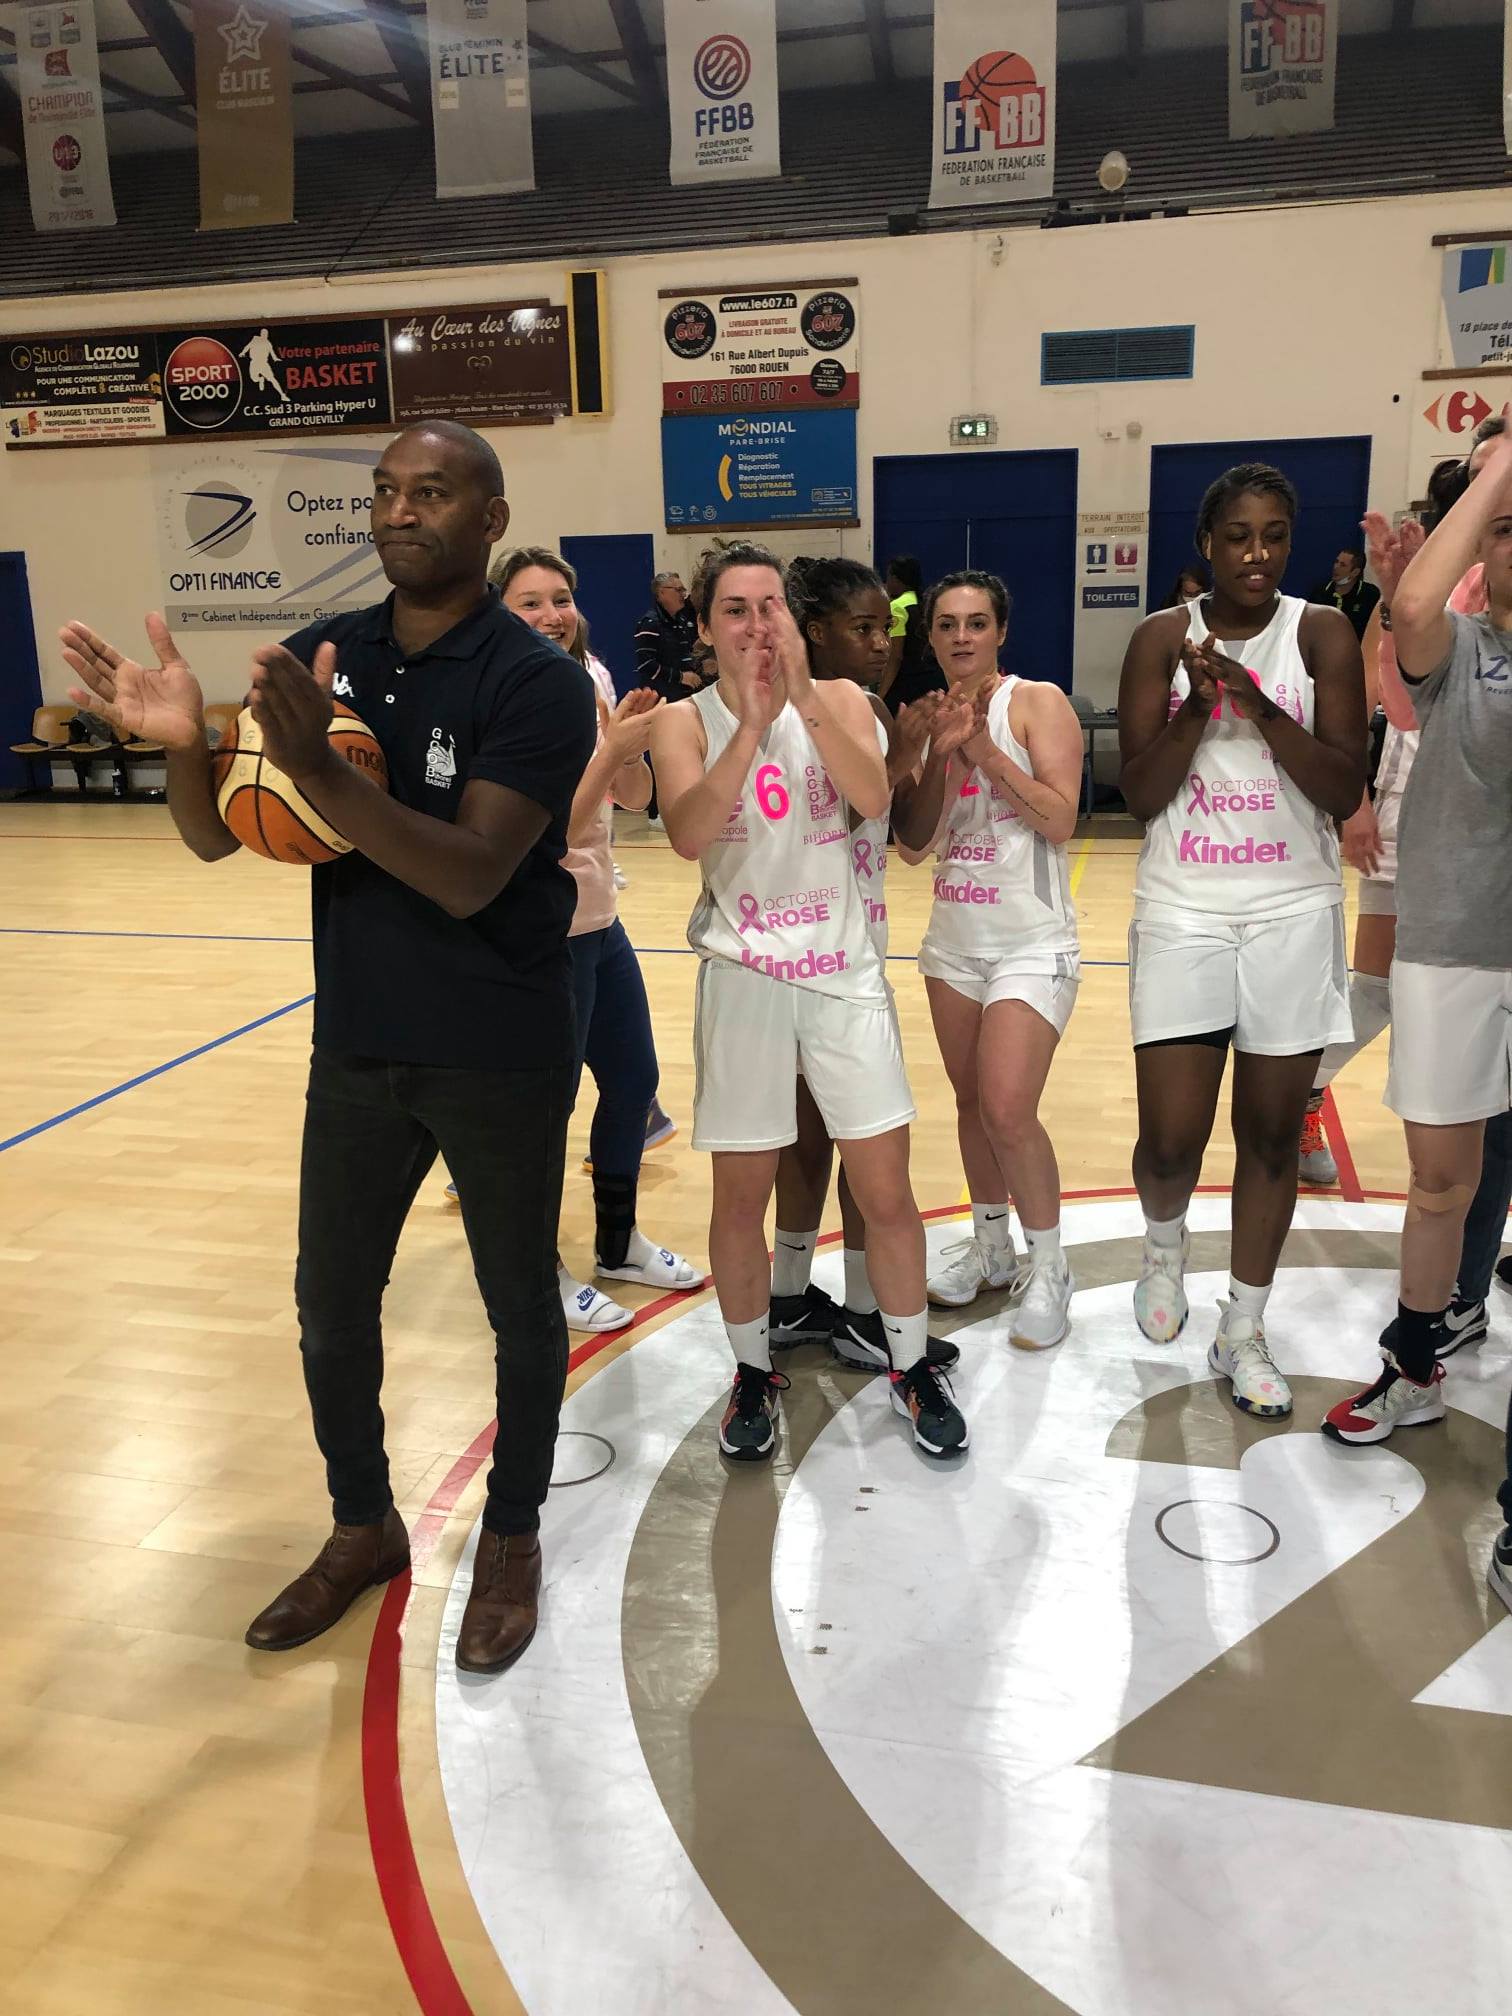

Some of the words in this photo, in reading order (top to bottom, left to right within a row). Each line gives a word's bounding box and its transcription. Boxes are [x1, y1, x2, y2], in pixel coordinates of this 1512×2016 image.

[441, 53, 504, 78] ÉLITE
[219, 66, 271, 93] ÉLITE
[695, 102, 754, 137] FFBB
[743, 145, 753, 153] DE
[699, 155, 750, 165] BASKETBALL
[960, 176, 970, 186] DE
[975, 172, 1026, 185] BASKETBALL
[722, 297, 795, 310] www.le607.fr
[400, 317, 425, 338] Au
[431, 315, 473, 341] Cœur
[479, 314, 504, 334] des
[507, 310, 561, 338] Vignes
[675, 323, 705, 341] 607
[812, 314, 844, 333] 607
[1472, 321, 1499, 333] place
[727, 329, 753, 338] DOMICILE
[773, 327, 796, 335] BUREAU
[278, 346, 312, 359] Votre
[315, 341, 380, 359] partenaire
[431, 340, 494, 353] passion
[504, 336, 521, 346] du
[531, 335, 555, 345] vin
[710, 352, 725, 362] 161
[728, 351, 745, 360] Rue
[748, 348, 775, 360] Albert
[778, 347, 809, 360] Dupuis
[171, 364, 232, 384] SPORT
[286, 361, 377, 390] BASKET
[729, 364, 756, 374] 76000
[759, 362, 789, 372] ROUEN
[37, 378, 56, 386] POUR
[74, 374, 135, 383] COMMUNICATION
[54, 385, 97, 396] COMPLÈTE
[108, 383, 149, 393] CRÉATIVE
[179, 383, 229, 401] 2000
[690, 386, 706, 405] 02
[711, 384, 727, 403] 35
[731, 383, 755, 402] 607
[759, 381, 784, 401] 607
[43, 408, 81, 417] MARQUAGES
[82, 407, 112, 415] TEXTILES
[122, 406, 149, 414] GOODIES
[243, 405, 263, 417] C.C.
[264, 404, 284, 415] Sud
[286, 404, 292, 414] 3
[294, 400, 333, 415] Parking
[335, 399, 365, 412] Hyper
[368, 398, 376, 408] U
[269, 416, 301, 427] GRAND
[303, 413, 345, 426] QUEVILLY
[718, 419, 796, 437] MONDIAL
[729, 437, 786, 446] PARE-BRISE
[738, 452, 779, 462] Diagnostic
[738, 462, 780, 472] Réparation
[738, 472, 794, 482] Remplacement
[758, 482, 792, 490] VITRAGES
[287, 490, 344, 516] Optez
[170, 573, 206, 591] OPTI
[1086, 593, 1136, 602] TOILETTES
[201, 611, 236, 622] Cabinet
[239, 609, 296, 623] Indépendant
[425, 777, 451, 789] BASKET
[1211, 778, 1284, 793] OCTOBRE
[755, 763, 790, 821] 6
[1212, 793, 1275, 812] ROSE
[952, 833, 1004, 846] OCTOBRE
[1179, 830, 1287, 864] Kinder
[950, 846, 995, 862] ROSE
[933, 874, 1000, 904] Kinder
[763, 887, 841, 911] OCTOBRE
[766, 903, 831, 929] ROSE
[576, 1286, 594, 1305] NIKE
